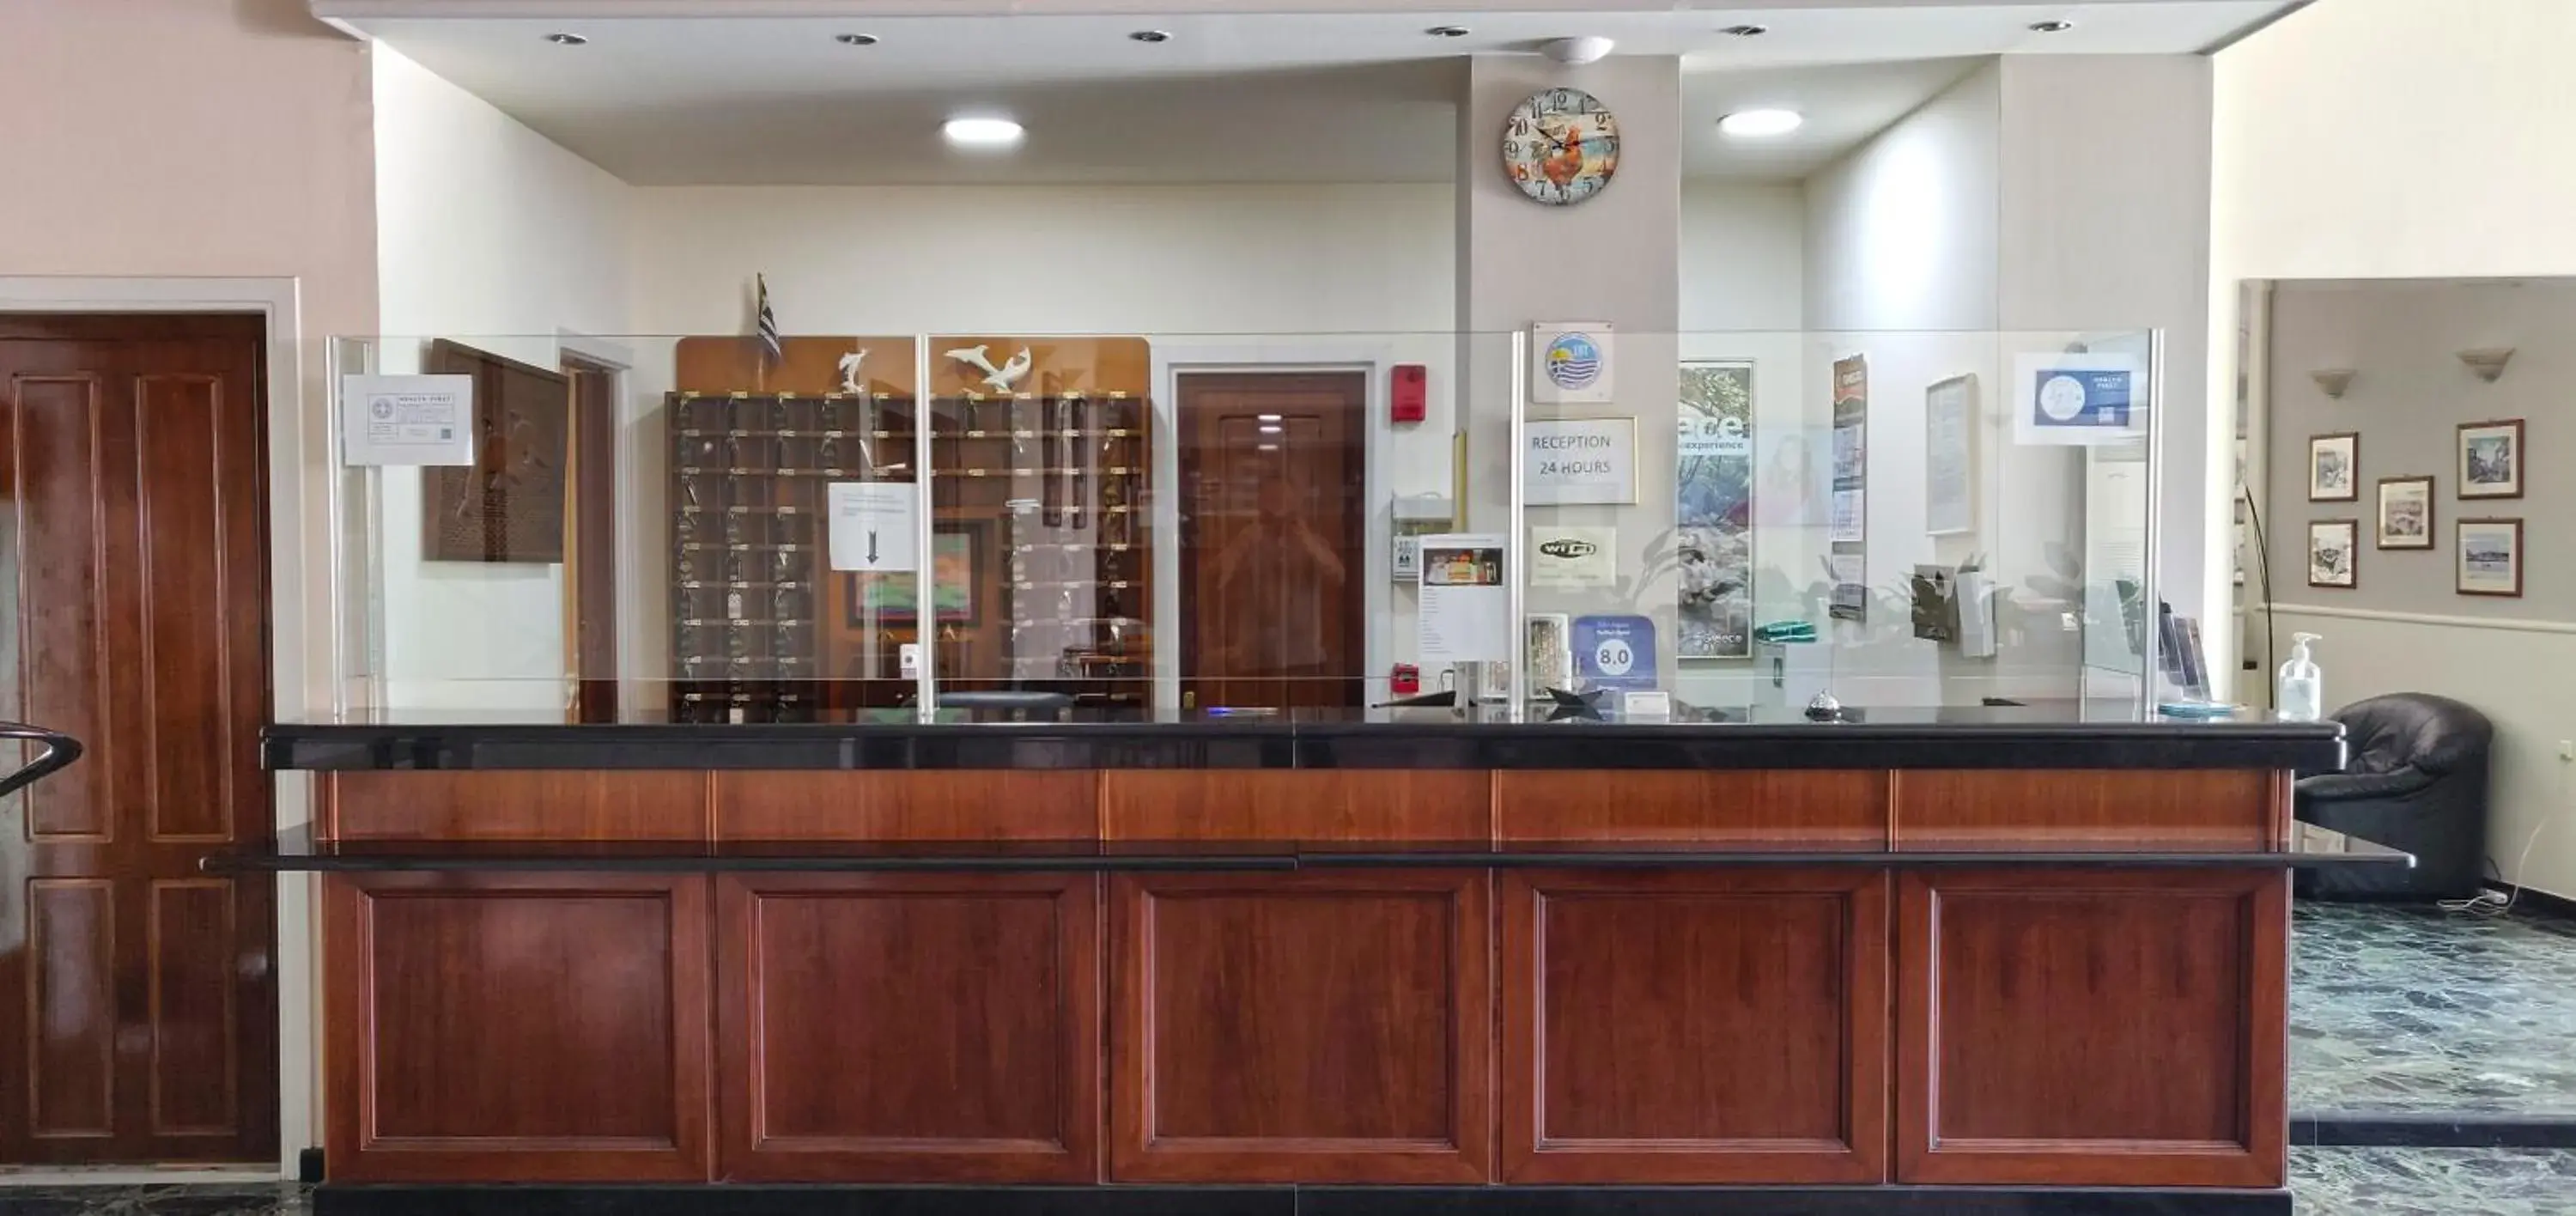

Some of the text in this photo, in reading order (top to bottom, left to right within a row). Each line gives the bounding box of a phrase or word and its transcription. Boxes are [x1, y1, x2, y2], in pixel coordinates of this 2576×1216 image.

[1532, 435, 1610, 449] RECEPTION
[1540, 461, 1611, 474] 24 HOURS
[1600, 648, 1629, 665] 8.0
